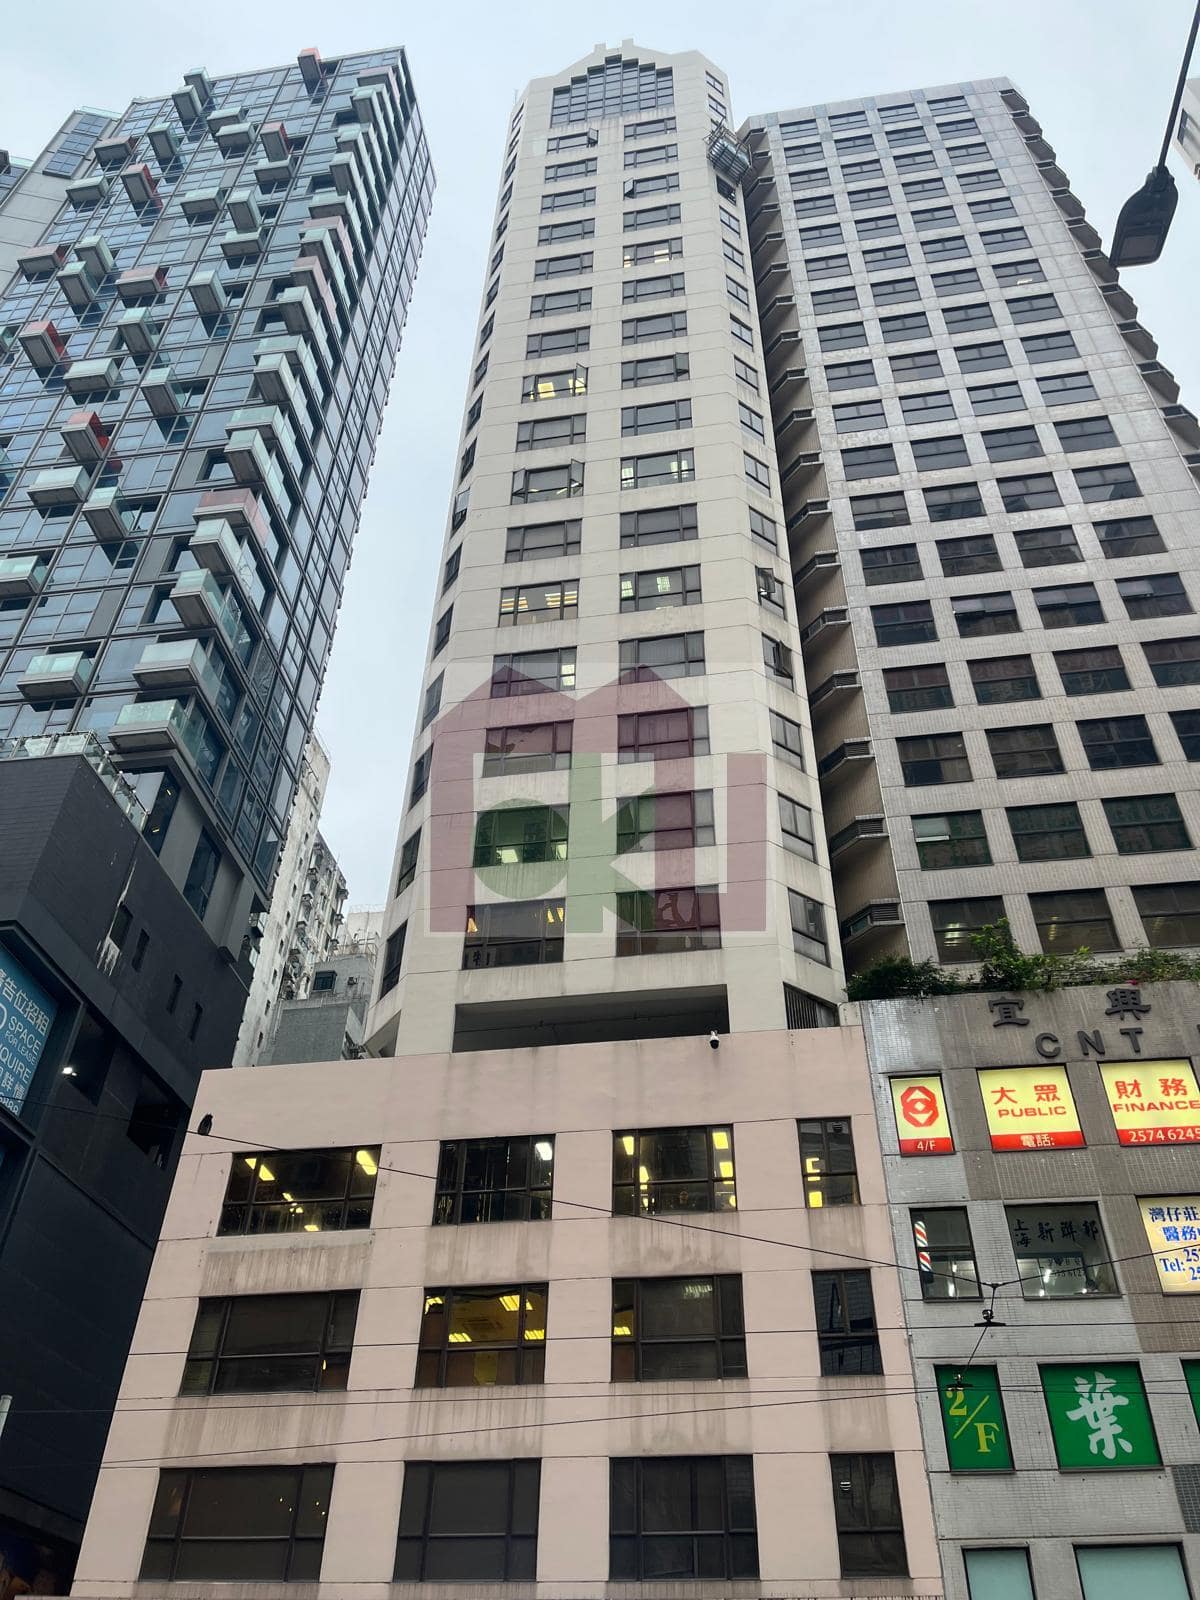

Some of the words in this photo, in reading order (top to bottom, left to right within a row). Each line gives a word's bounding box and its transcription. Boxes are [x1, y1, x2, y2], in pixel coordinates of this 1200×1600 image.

[8, 1016, 41, 1056] SPACE
[1035, 1027, 1143, 1058] CNT
[5, 1031, 18, 1047] FOR
[18, 1044, 37, 1065] LEASE
[0, 1043, 31, 1083] QUIRE
[1115, 1078, 1188, 1099] 財務
[998, 1106, 1067, 1118] PUBLIC
[1113, 1100, 1200, 1112] FINANCE
[917, 1140, 936, 1151] 4/F
[1162, 1225, 1200, 1241] 醫務
[1159, 1258, 1186, 1271] Tel:
[1184, 1248, 1200, 1262] 25
[945, 1387, 1000, 1453] 2/F
